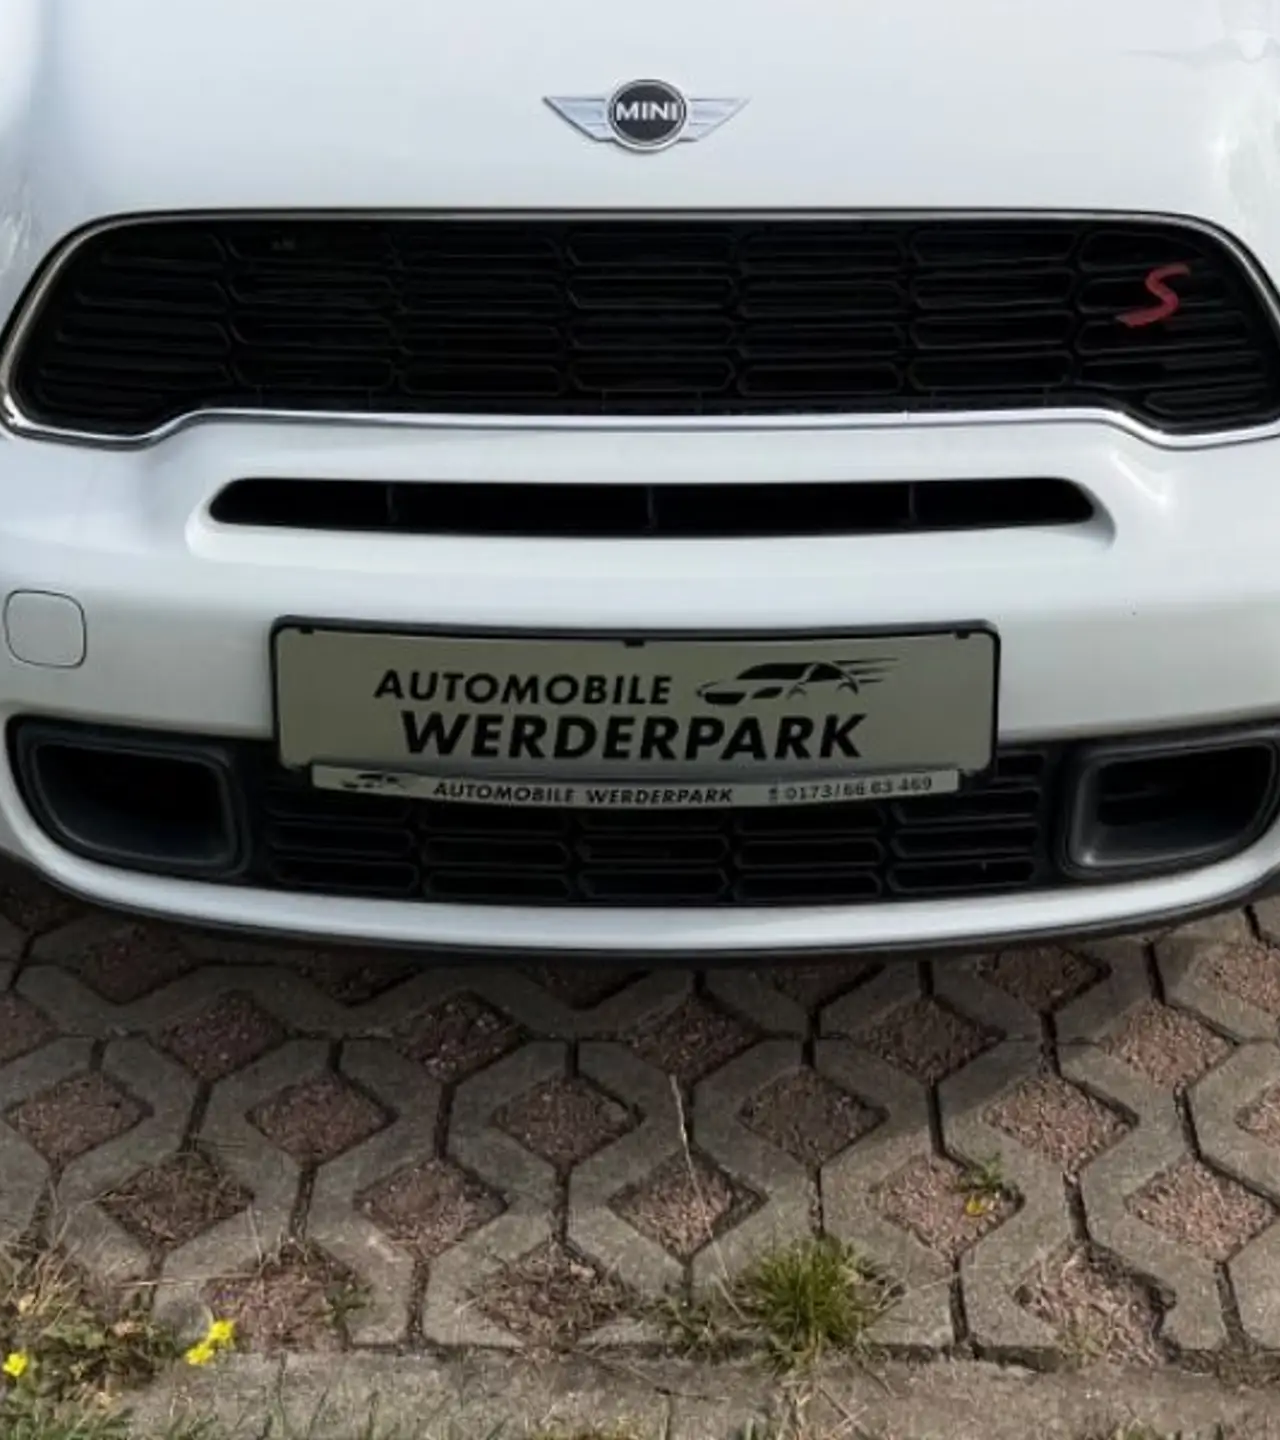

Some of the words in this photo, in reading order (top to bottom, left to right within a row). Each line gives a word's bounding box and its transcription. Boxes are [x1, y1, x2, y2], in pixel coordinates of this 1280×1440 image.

[615, 100, 680, 122] MINI
[1116, 263, 1191, 328] S
[373, 669, 674, 707] AUTOMOBILE
[402, 710, 868, 762] WERDERPARK
[432, 782, 575, 804] AUTOMOBILE
[586, 787, 735, 805] WERDERPARK
